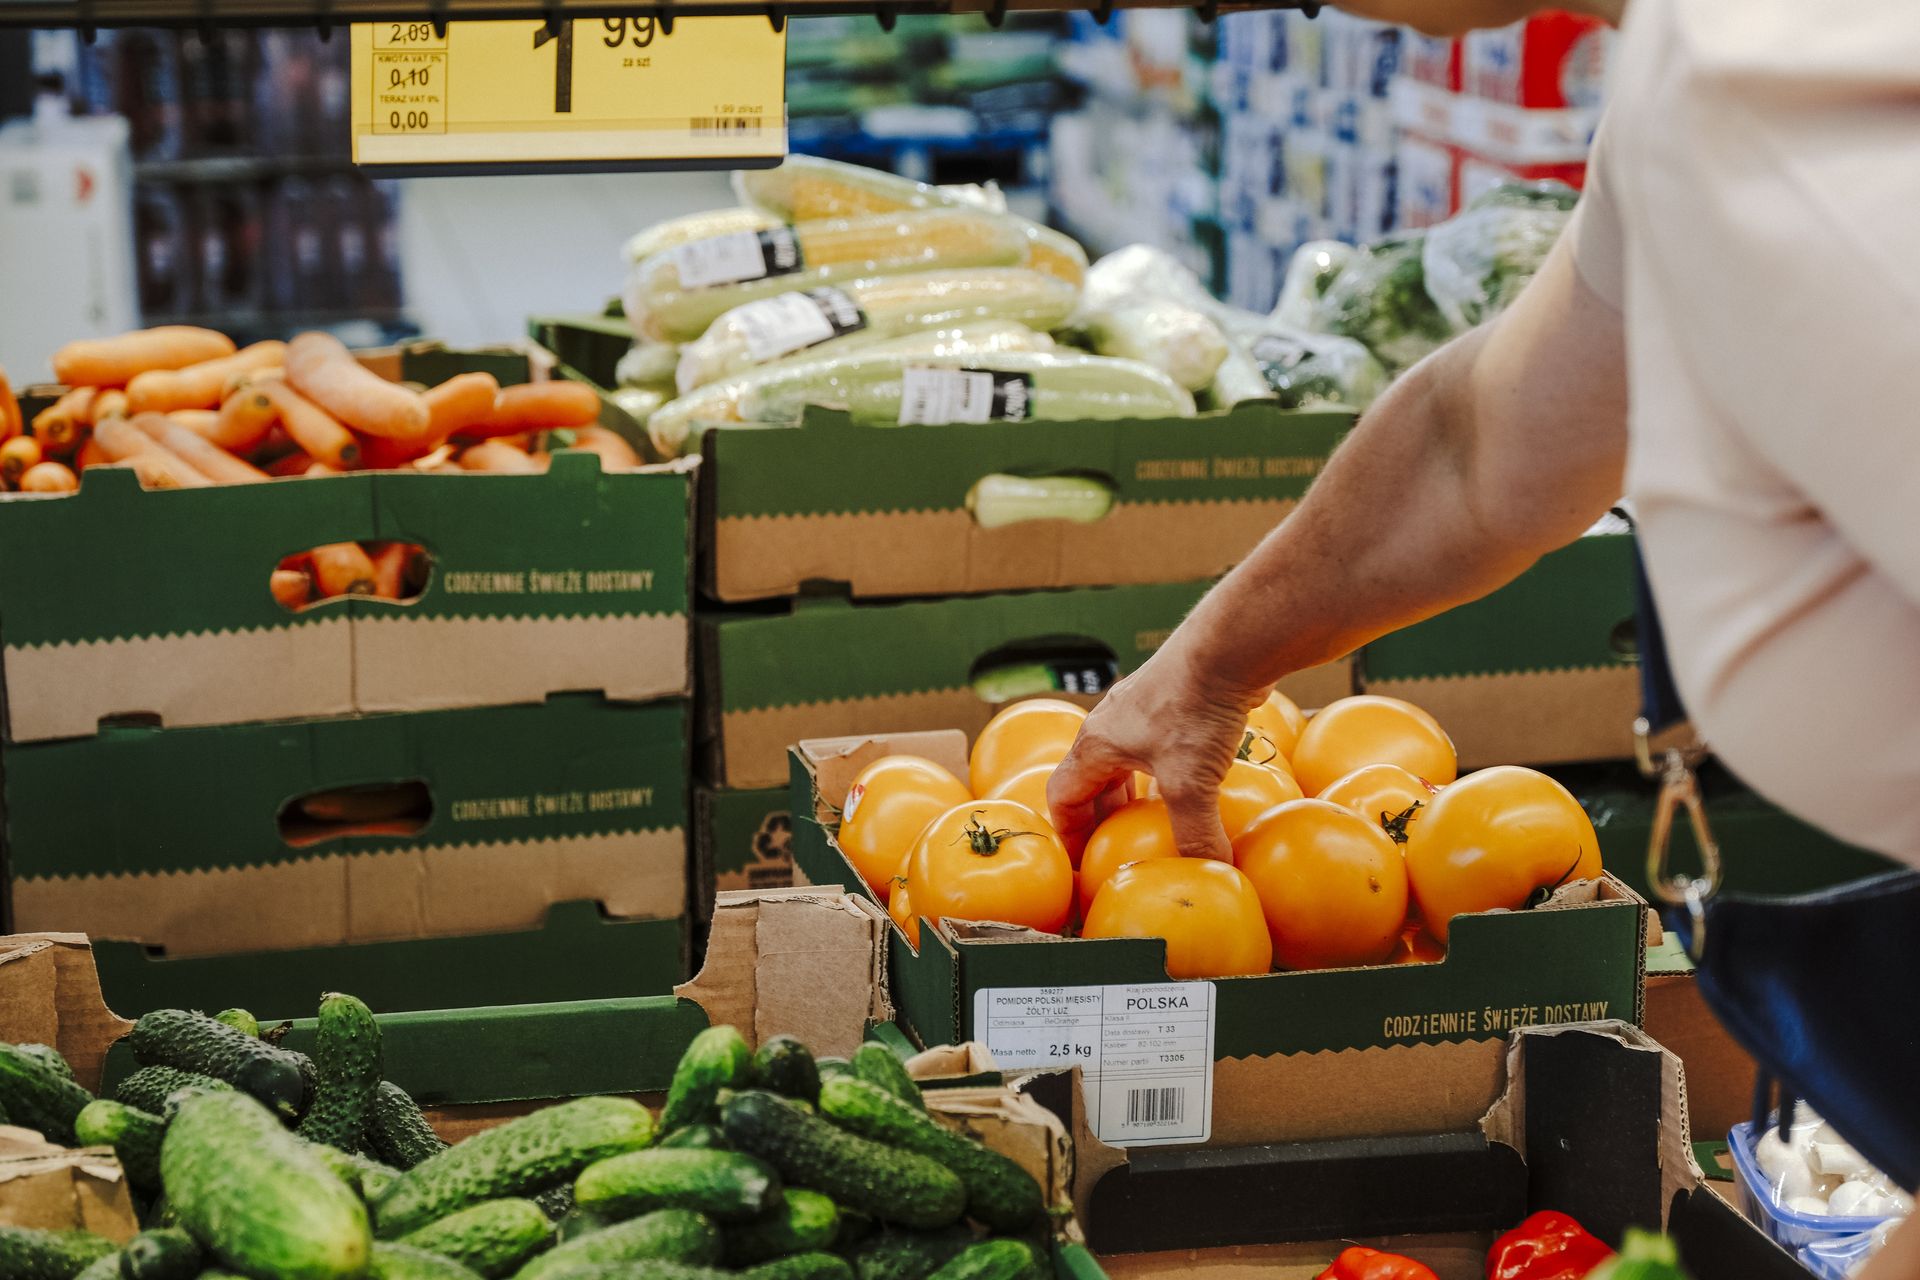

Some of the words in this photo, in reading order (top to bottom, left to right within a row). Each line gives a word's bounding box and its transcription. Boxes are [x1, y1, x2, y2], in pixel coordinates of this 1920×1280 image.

[391, 24, 430, 44] 2,09
[533, 17, 573, 113] 1
[603, 17, 655, 48] 99
[622, 58, 633, 67] za
[391, 68, 429, 88] 0,10
[380, 95, 407, 103] TERAZ
[409, 95, 424, 103] VAT
[390, 111, 428, 131] 0,00
[996, 997, 1033, 1005] POMIDOR
[1035, 996, 1064, 1005] POLSKI
[1127, 996, 1189, 1010] POLSKA
[1545, 1001, 1609, 1024] DOSTAWY
[1165, 1025, 1176, 1033] 33
[991, 1048, 1013, 1056] Masa
[1015, 1047, 1037, 1056] netto
[1049, 1044, 1070, 1058] 2,5
[1075, 1043, 1092, 1058] kg
[1160, 1054, 1185, 1063] T3305
